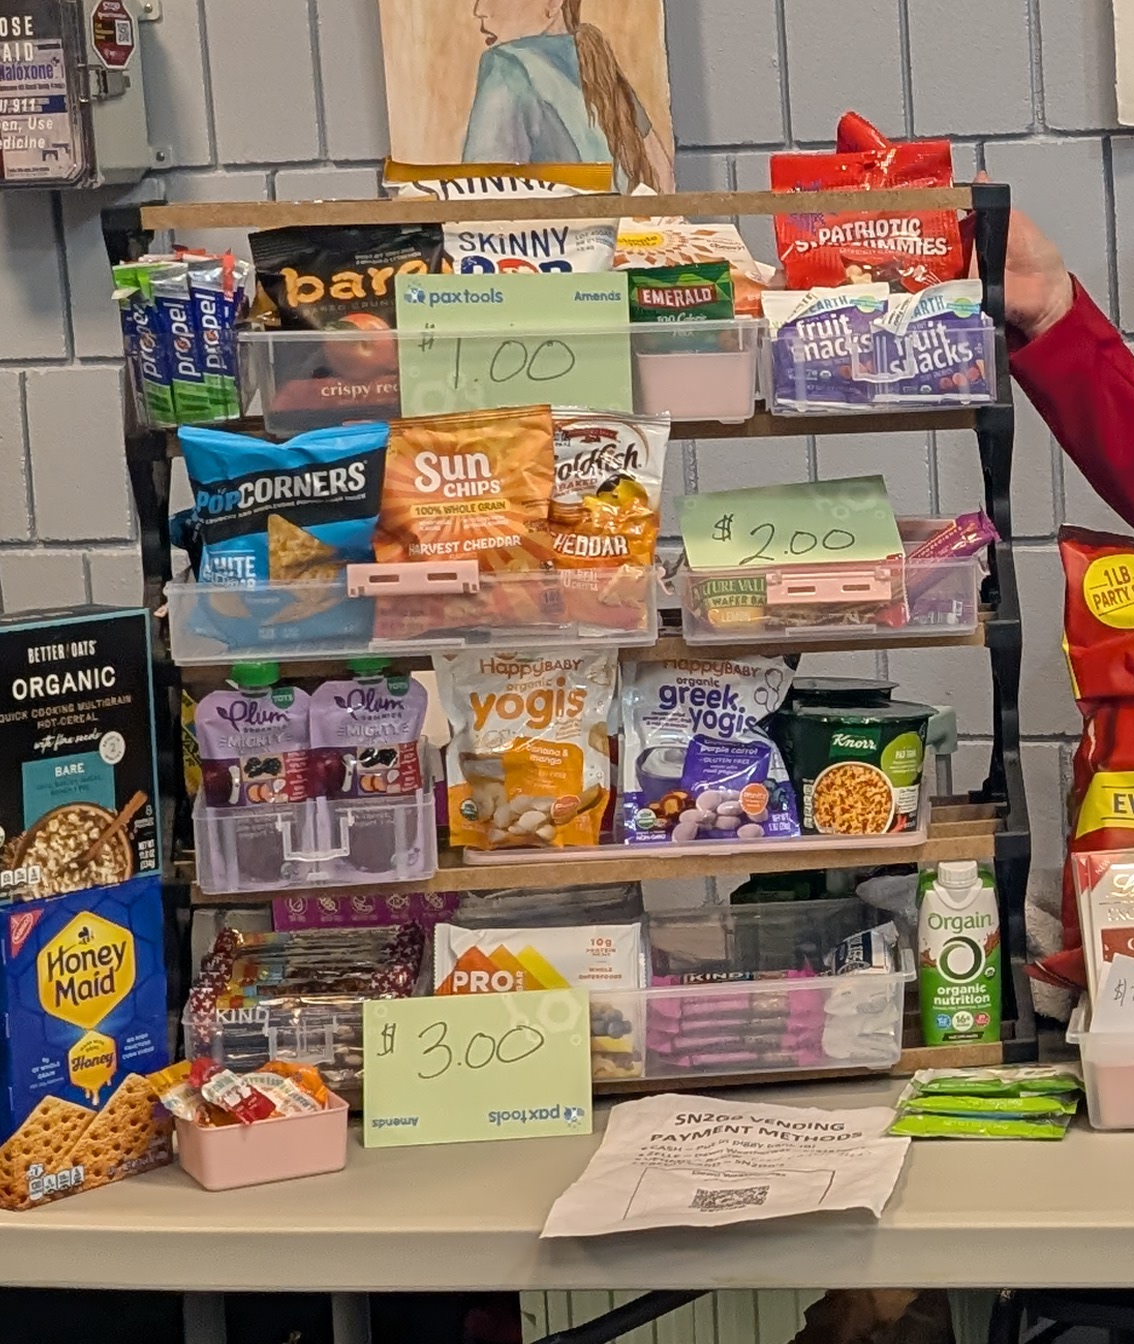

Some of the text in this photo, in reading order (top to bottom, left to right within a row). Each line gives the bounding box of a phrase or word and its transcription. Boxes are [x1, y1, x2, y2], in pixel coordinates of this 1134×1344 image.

[2, 42, 35, 62] AID
[28, 117, 54, 131] Use
[413, 176, 557, 201] KINN
[818, 217, 922, 245] PATRIOTIC
[574, 290, 622, 303] Amends
[641, 287, 713, 307] EMERALD
[194, 291, 228, 371] propel
[796, 312, 854, 340] fruit
[170, 301, 202, 377] propel
[894, 319, 950, 354] fruit
[320, 381, 372, 397] crispy
[414, 449, 492, 494] Sun
[554, 442, 640, 481] oldfish
[443, 479, 501, 498] CHIPS
[414, 501, 506, 517] 100% WHOLE GRAIN
[408, 535, 522, 556] HARVEST CHEDDAR
[1092, 585, 1132, 610] PARTY
[27, 640, 97, 664] BETTER OATS
[11, 665, 117, 701] ORGANIC
[505, 678, 552, 693] organic
[675, 676, 721, 688] organic
[31, 702, 75, 719] COOKING
[77, 694, 133, 711] MULTIGRAIN
[334, 688, 405, 720] Plum
[469, 675, 588, 732] yogis
[658, 683, 739, 710] greek
[58, 712, 99, 727] CEREAL
[217, 700, 289, 732] Plum
[688, 706, 757, 738] yogis
[346, 723, 401, 738] MIGHTY
[227, 734, 285, 749] MIGHTY
[831, 733, 877, 751] Knorr
[529, 754, 564, 766] mango
[561, 747, 569, 757] &
[54, 762, 85, 778] BARE
[927, 911, 992, 935] Orgain
[590, 937, 612, 948] 10g
[46, 941, 127, 983] Honey
[55, 967, 116, 1008] Maid
[453, 969, 515, 993] PRO
[688, 972, 747, 983] KIND
[933, 992, 991, 1007] nutrition
[936, 982, 988, 999] organic
[216, 1006, 270, 1024] KIND
[376, 1021, 546, 1081] $3.00
[71, 1051, 115, 1073] Honey
[371, 1116, 420, 1129] Amends
[750, 1115, 846, 1132] VENDING
[649, 1124, 863, 1143] PAYMENT METHODS
